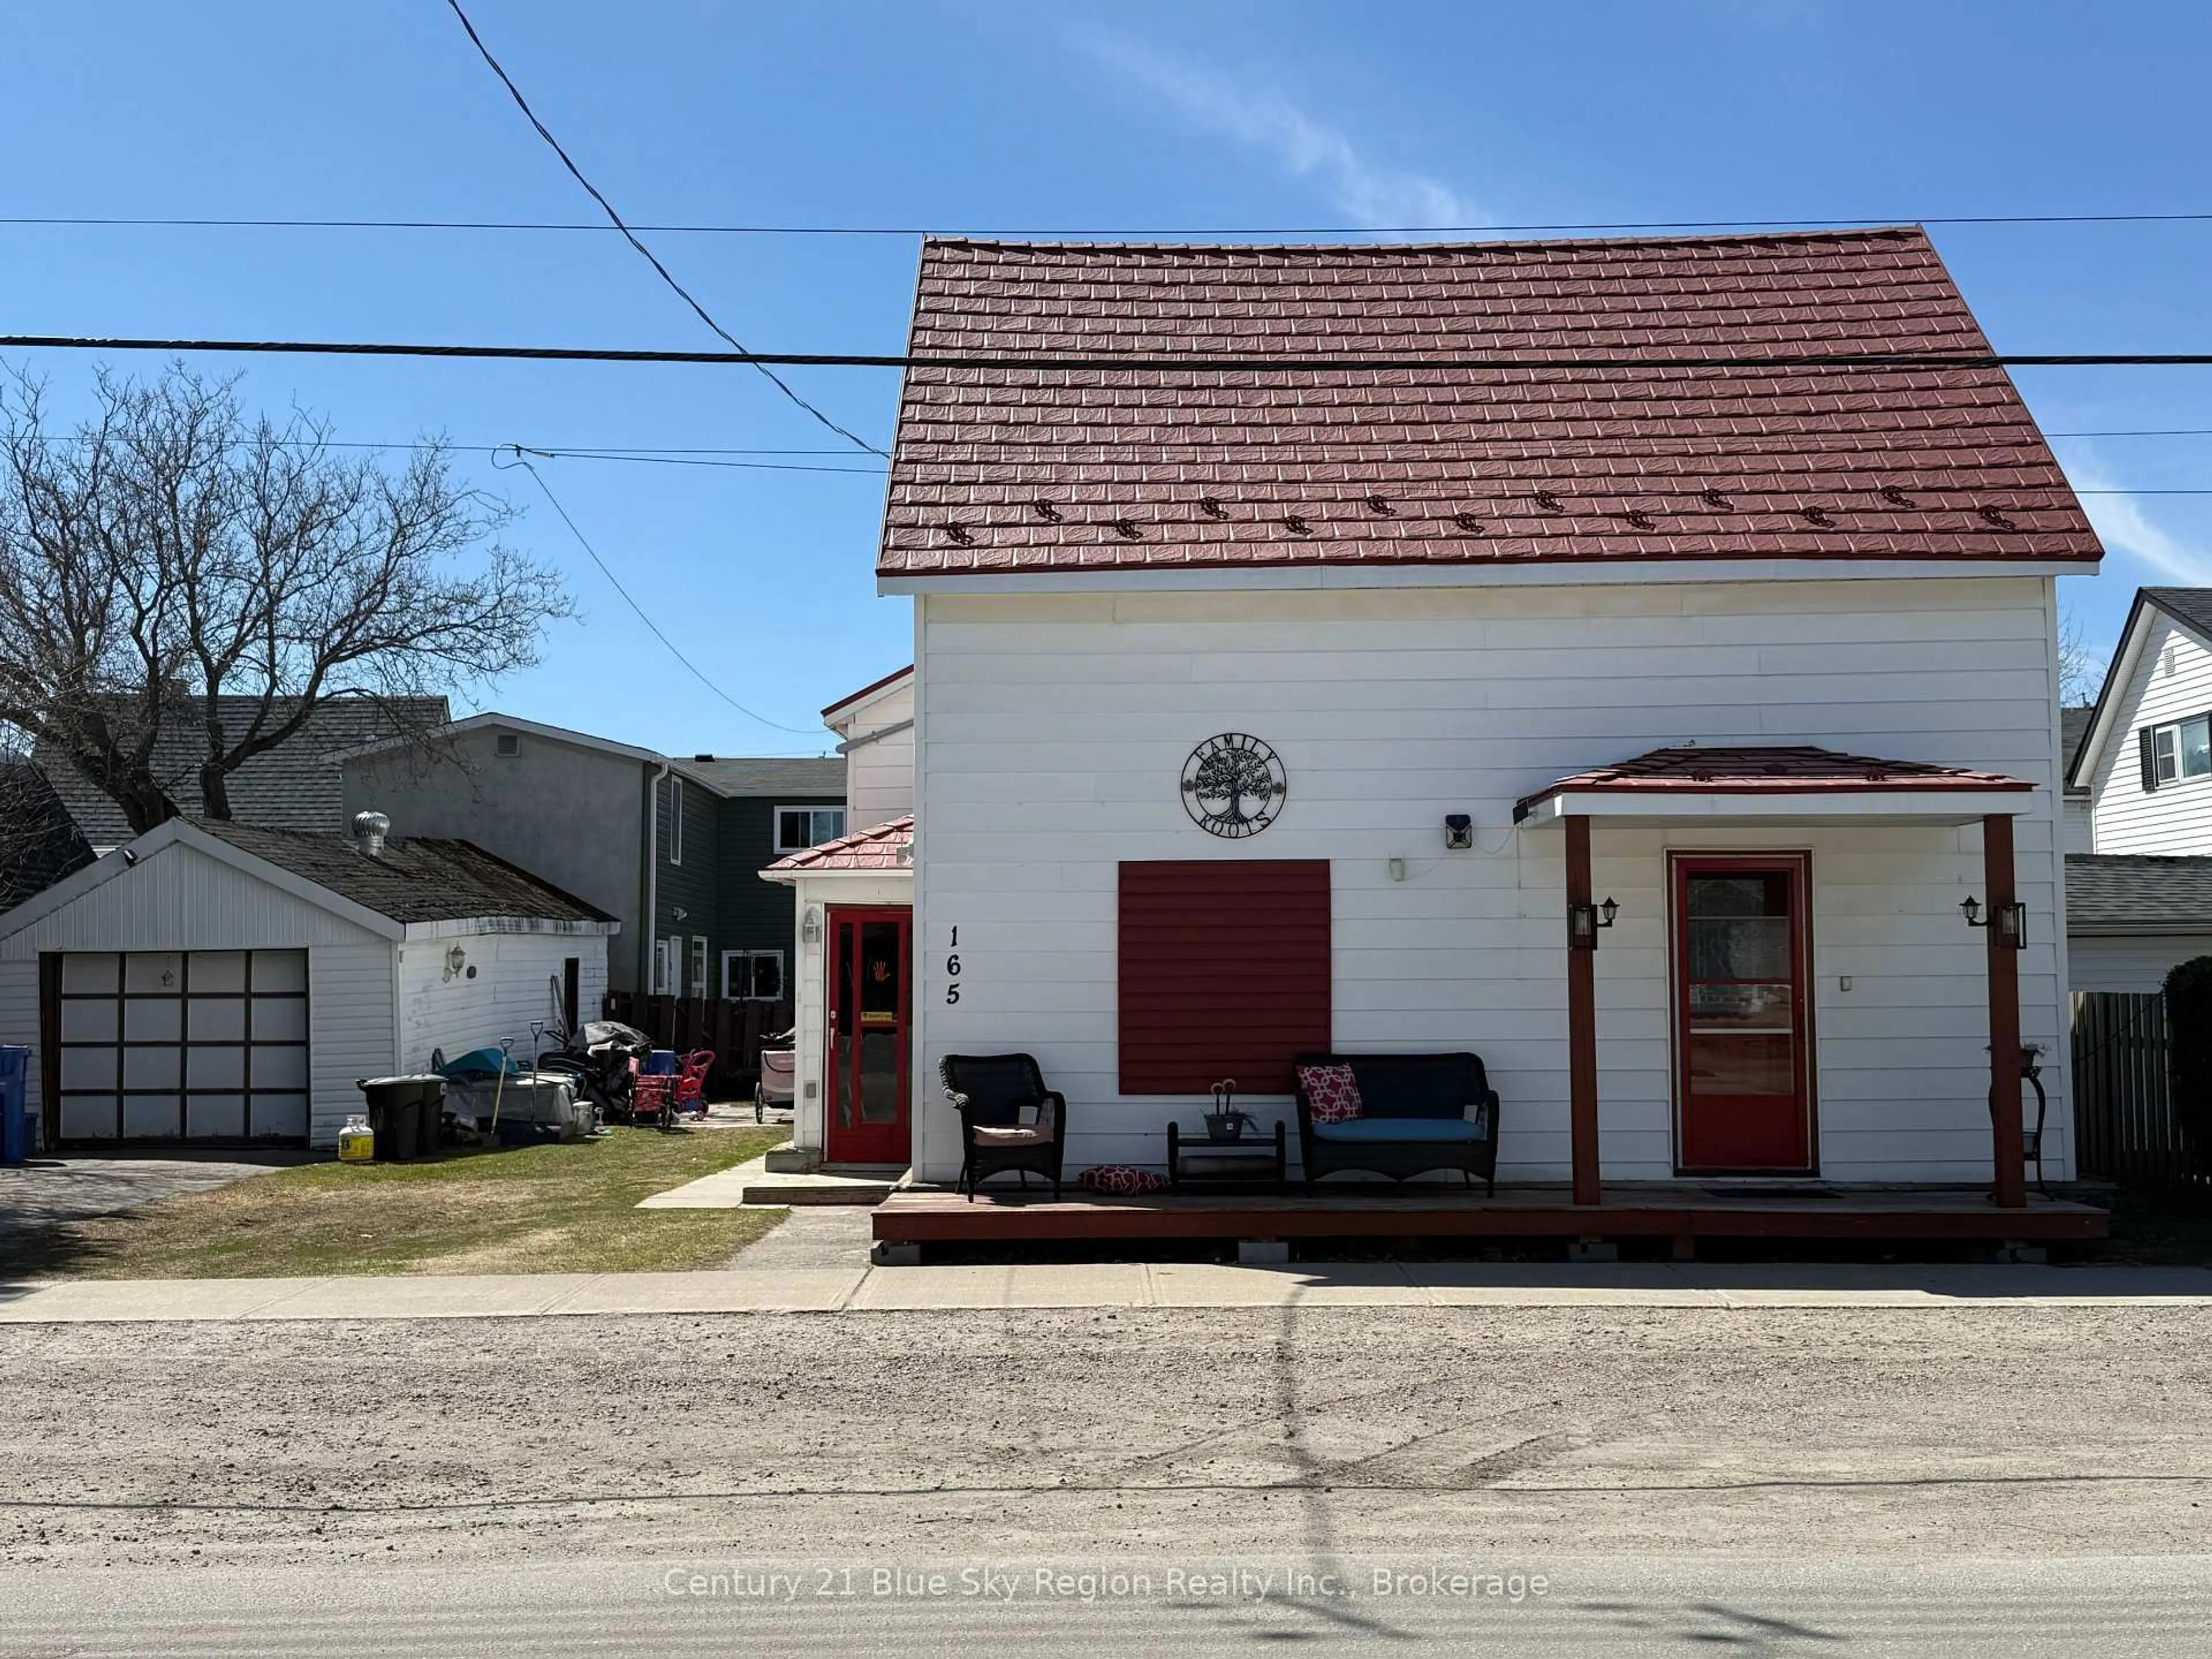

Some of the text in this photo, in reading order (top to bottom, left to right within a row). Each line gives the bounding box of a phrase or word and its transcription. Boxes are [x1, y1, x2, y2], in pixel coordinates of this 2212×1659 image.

[1195, 733, 1276, 763] FAMILY
[1198, 811, 1272, 838] ROOTS
[946, 925, 961, 1005] 165
